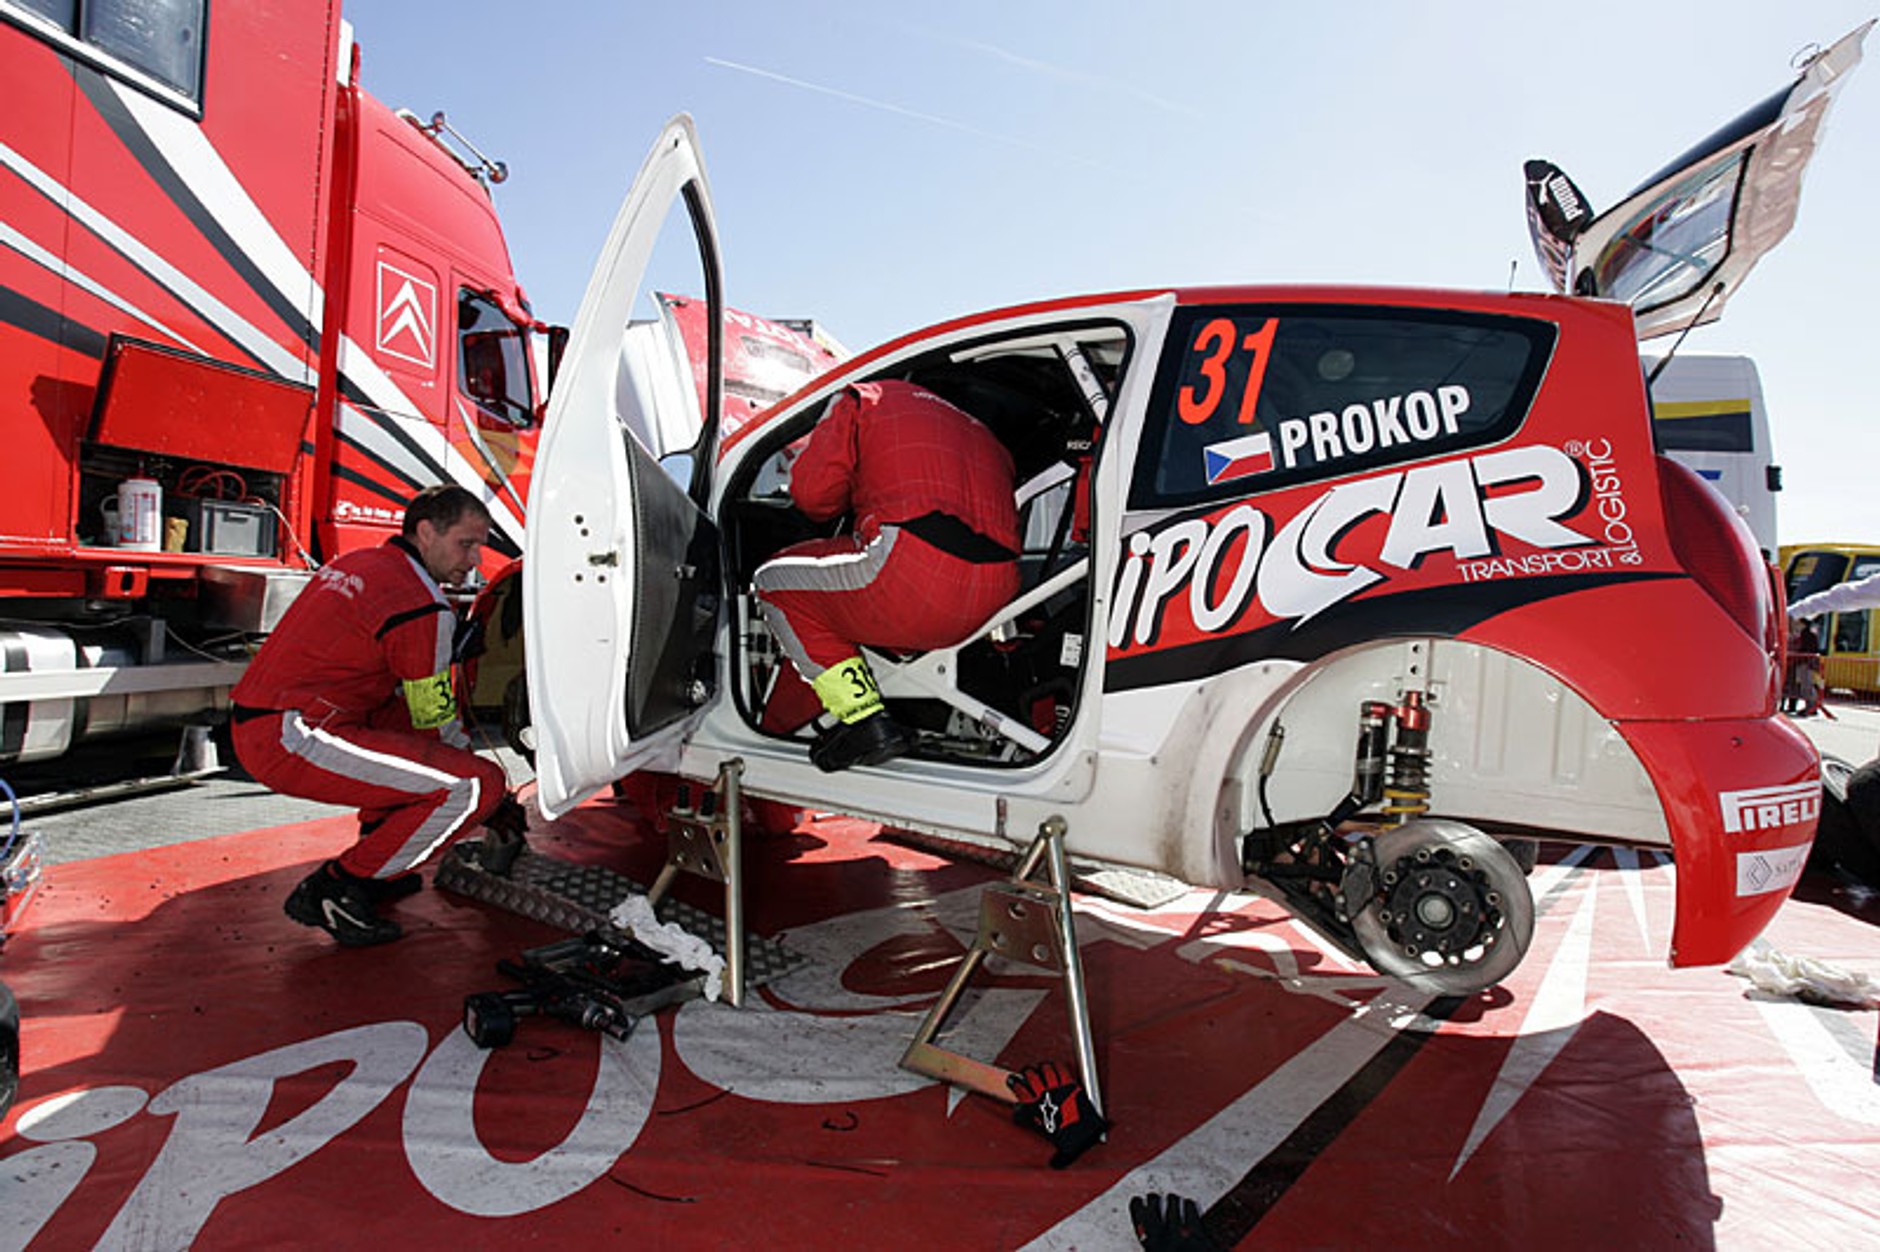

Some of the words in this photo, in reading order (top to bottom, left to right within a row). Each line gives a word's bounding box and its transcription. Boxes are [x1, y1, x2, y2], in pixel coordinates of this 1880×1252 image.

[1178, 317, 1280, 424] 31
[1279, 385, 1470, 469] PROKOP
[1456, 550, 1612, 582] TRANSPORT
